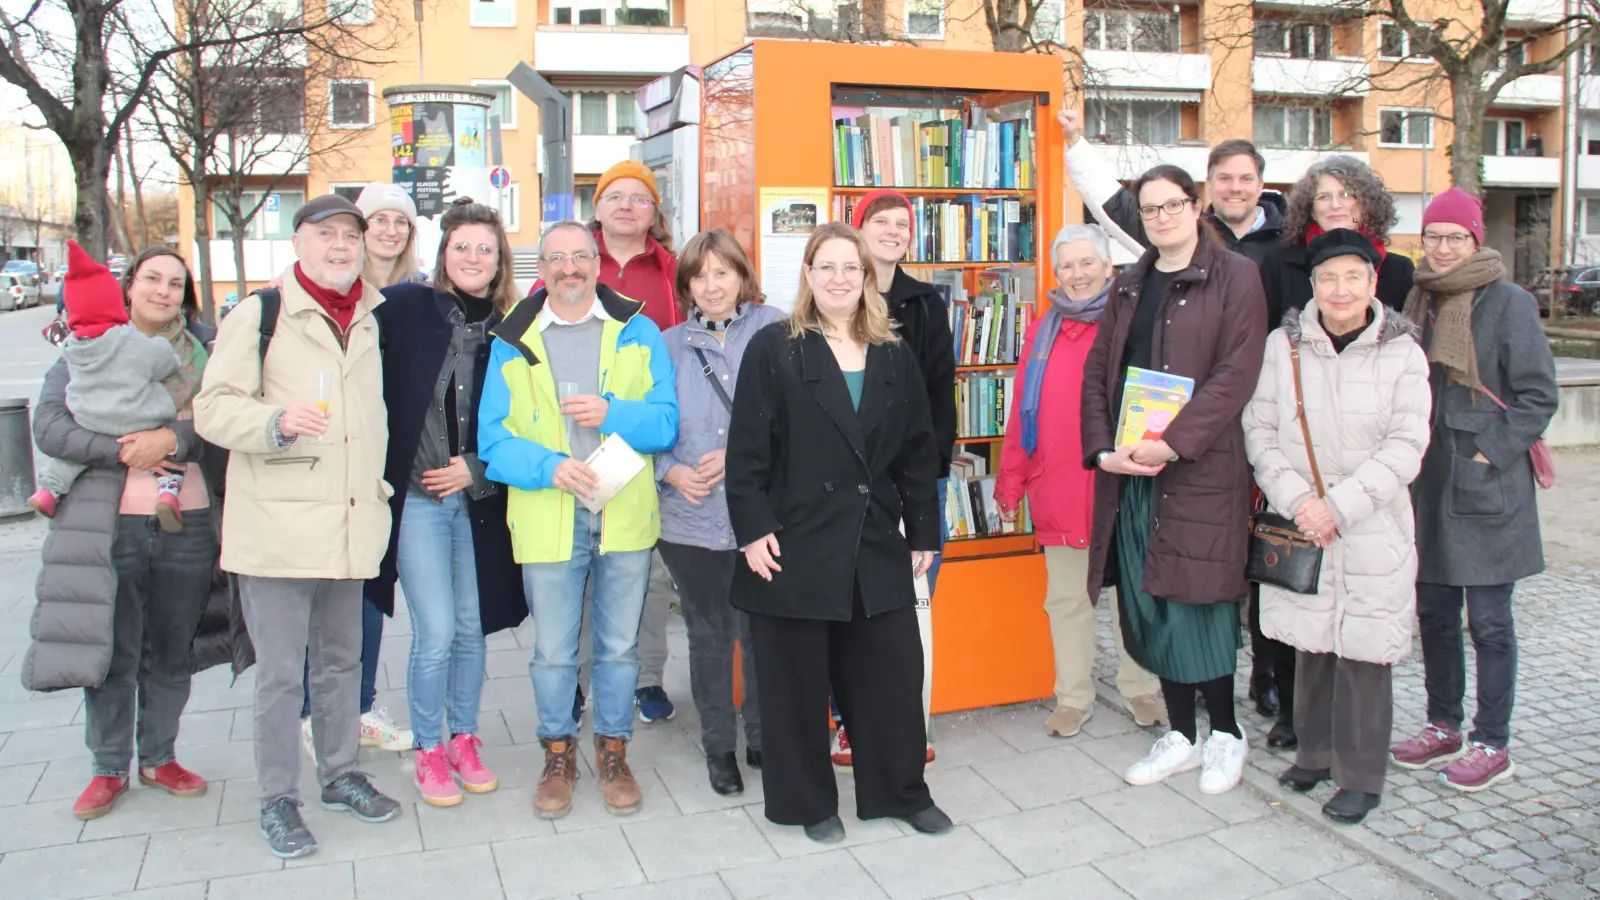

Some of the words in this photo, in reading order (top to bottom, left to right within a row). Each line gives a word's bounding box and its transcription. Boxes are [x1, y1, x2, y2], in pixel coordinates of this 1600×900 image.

[413, 92, 454, 101] KULTUR
[266, 196, 276, 210] P
[995, 389, 1003, 409] Rage
